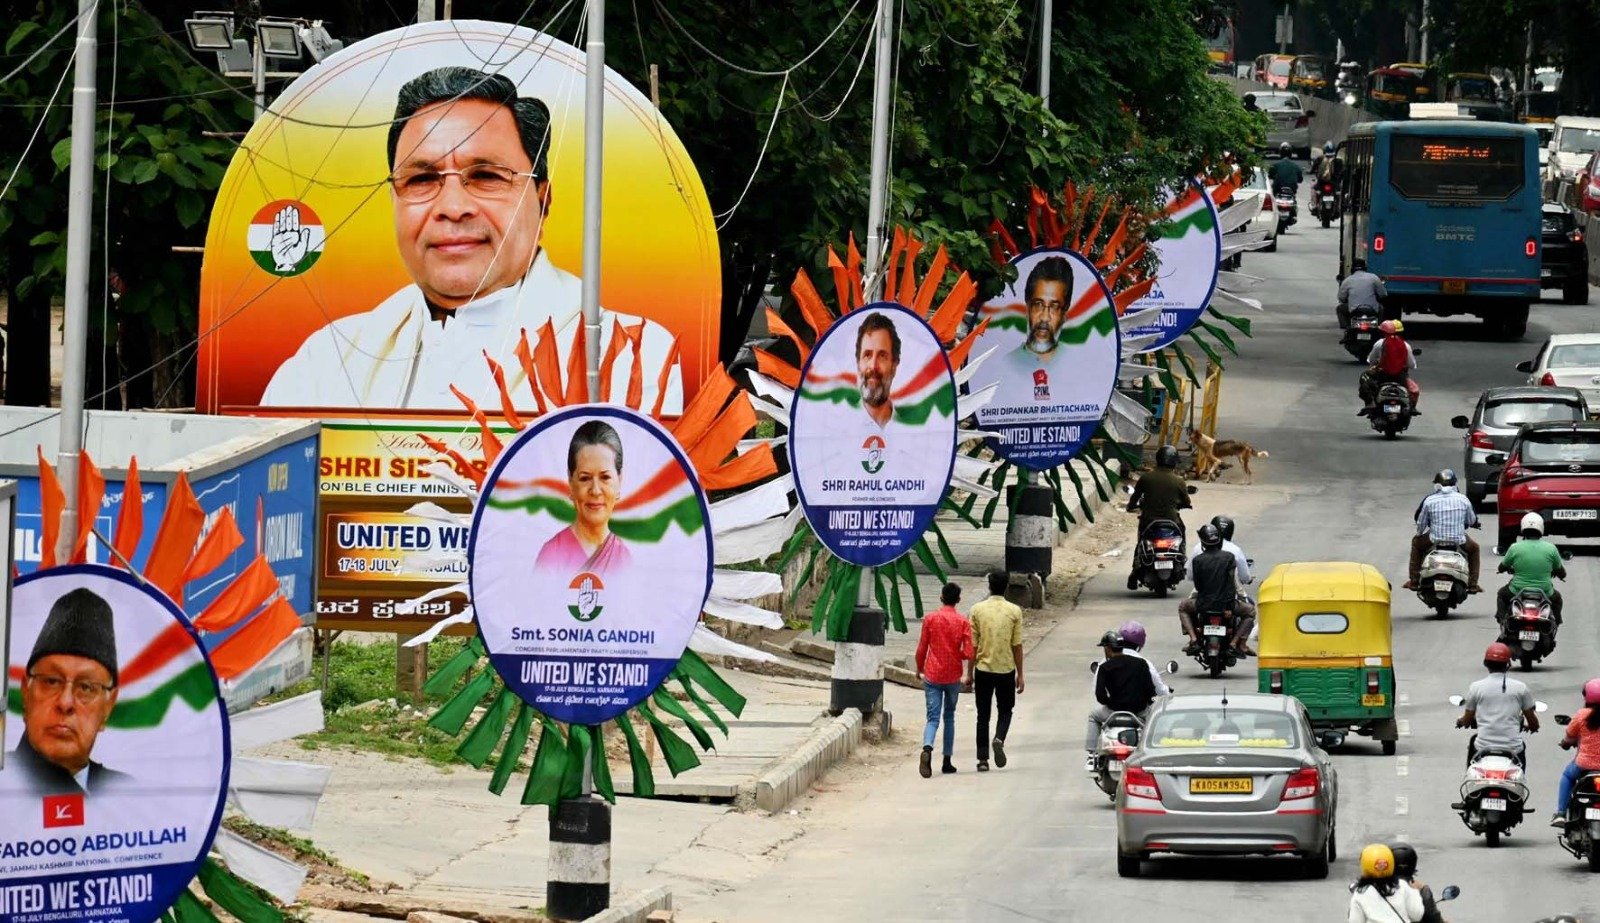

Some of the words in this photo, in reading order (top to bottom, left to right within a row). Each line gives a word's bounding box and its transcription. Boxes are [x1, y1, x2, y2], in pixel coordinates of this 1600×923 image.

[1435, 232, 1475, 241] BMTC
[1144, 289, 1165, 299] AJA
[1153, 312, 1178, 327] AND!
[981, 407, 999, 417] SHRI
[1000, 406, 1040, 416] DIPANKAR
[1040, 403, 1100, 413] BHATTACHARYA
[999, 427, 1030, 445] UNITED
[1032, 426, 1047, 444] WE
[1048, 425, 1081, 443] STAND!
[320, 456, 381, 478] SHRI
[376, 483, 417, 493] CHIEF
[421, 484, 477, 494] MINIS
[822, 479, 847, 491] SHRI
[849, 479, 882, 491] RAHUL
[884, 479, 925, 491] GANDHI
[828, 510, 861, 529] UNITED
[863, 510, 879, 529] WE
[880, 510, 915, 529] STAND!
[338, 523, 431, 549] UNITED
[338, 559, 366, 571] 17-18
[369, 559, 399, 572] JULY
[511, 627, 545, 641] Smt.
[548, 628, 594, 643] SONIA
[597, 629, 655, 644] GANDHI
[521, 661, 570, 684] UNITED
[572, 662, 595, 685] WE
[598, 663, 649, 687] STAND!
[0, 837, 77, 859] AROOQ
[82, 826, 187, 852] ABDULLAH
[10, 864, 38, 873] JAMMU
[39, 861, 74, 871] KASHMIR
[75, 857, 111, 868] NATIONAL
[114, 852, 163, 863] CONFERENCE
[49, 881, 80, 910] WE
[84, 873, 153, 907] STAND!
[85, 906, 123, 918] KARNATAKA
